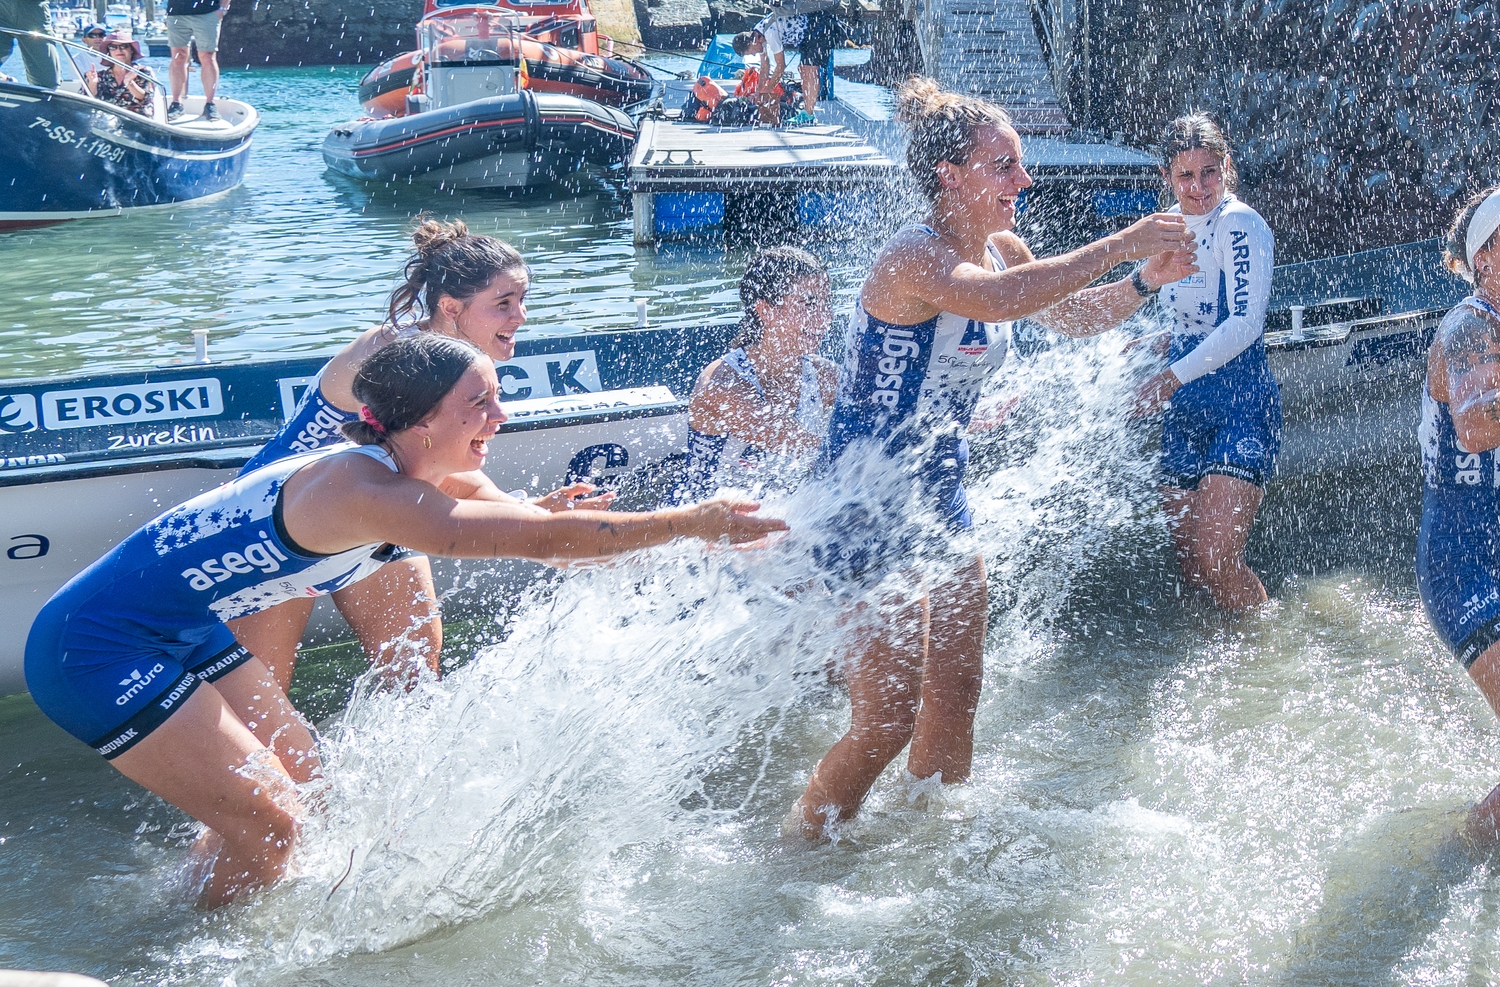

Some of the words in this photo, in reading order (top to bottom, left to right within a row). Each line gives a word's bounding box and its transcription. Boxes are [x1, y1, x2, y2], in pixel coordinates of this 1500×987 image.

[1229, 230, 1251, 317] ARRAUN
[872, 326, 921, 408] asegi
[55, 386, 211, 422] EROSKI
[288, 396, 346, 454] asegi
[181, 530, 289, 591] asegi
[116, 662, 165, 707] amura
[198, 651, 241, 681] RRAUN
